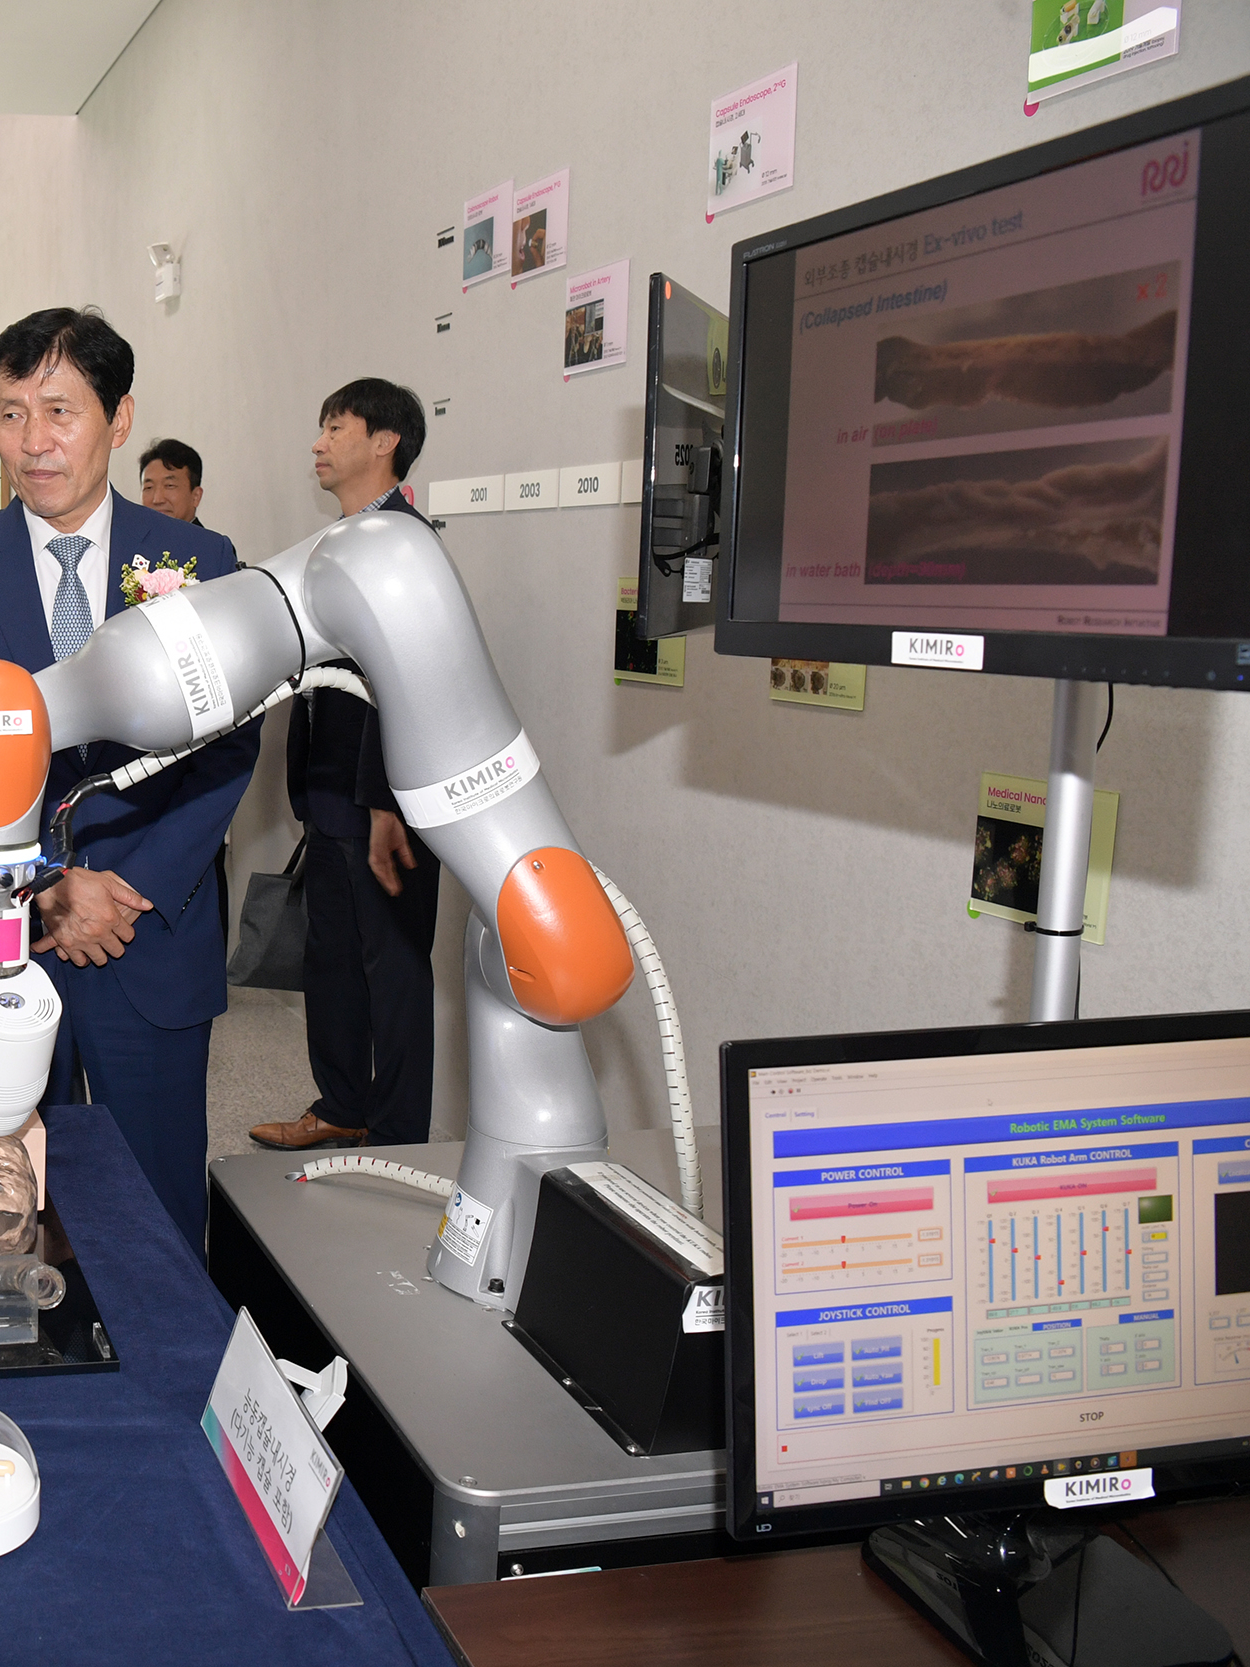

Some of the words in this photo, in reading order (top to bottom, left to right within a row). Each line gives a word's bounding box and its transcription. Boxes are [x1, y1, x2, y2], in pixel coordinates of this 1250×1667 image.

[716, 102, 738, 118] Capsule
[739, 88, 772, 108] Endoscope,
[853, 237, 918, 278] 캡슐내시경
[923, 222, 988, 257] Ex-vivo
[991, 210, 1024, 236] test
[800, 298, 873, 336] (Collapsed
[875, 278, 948, 314] Intestine)
[836, 428, 850, 444] in
[852, 426, 869, 442] air
[520, 482, 540, 498] 2003
[577, 476, 599, 494] 2010
[470, 487, 488, 502] 2001
[785, 563, 797, 578] in
[799, 564, 831, 578] water
[834, 562, 861, 578] bath
[909, 638, 964, 658] KIMIRo
[176, 640, 210, 716] KIMIRo
[444, 756, 515, 799] KIMIRo
[988, 786, 1022, 801] Medical
[987, 800, 1022, 814] 나노의료로봇
[1010, 1122, 1049, 1134] Robotic
[1053, 1119, 1077, 1130] EMA
[1080, 1118, 1117, 1130] System
[1121, 1114, 1165, 1125] Software
[1012, 1156, 1038, 1167] KUKA
[1040, 1154, 1066, 1164] Robot
[1069, 1153, 1087, 1162] Arm
[1090, 1149, 1132, 1160] CONTROL
[821, 1171, 856, 1182] POWER
[859, 1167, 904, 1178] CONTROL
[818, 1308, 863, 1321] JOYSTICK
[866, 1304, 911, 1317] CONTROL
[1133, 1312, 1159, 1321] MANUAL
[1043, 1321, 1071, 1330] POSITION
[1079, 1411, 1104, 1422] STOP
[243, 1388, 297, 1492] 능동캡슐내시경
[230, 1407, 255, 1462] (다기능
[257, 1455, 272, 1494] 캡슐
[272, 1489, 293, 1534] 포함)
[310, 1448, 331, 1487] KIMIRo
[1066, 1477, 1131, 1496] KIMIRo
